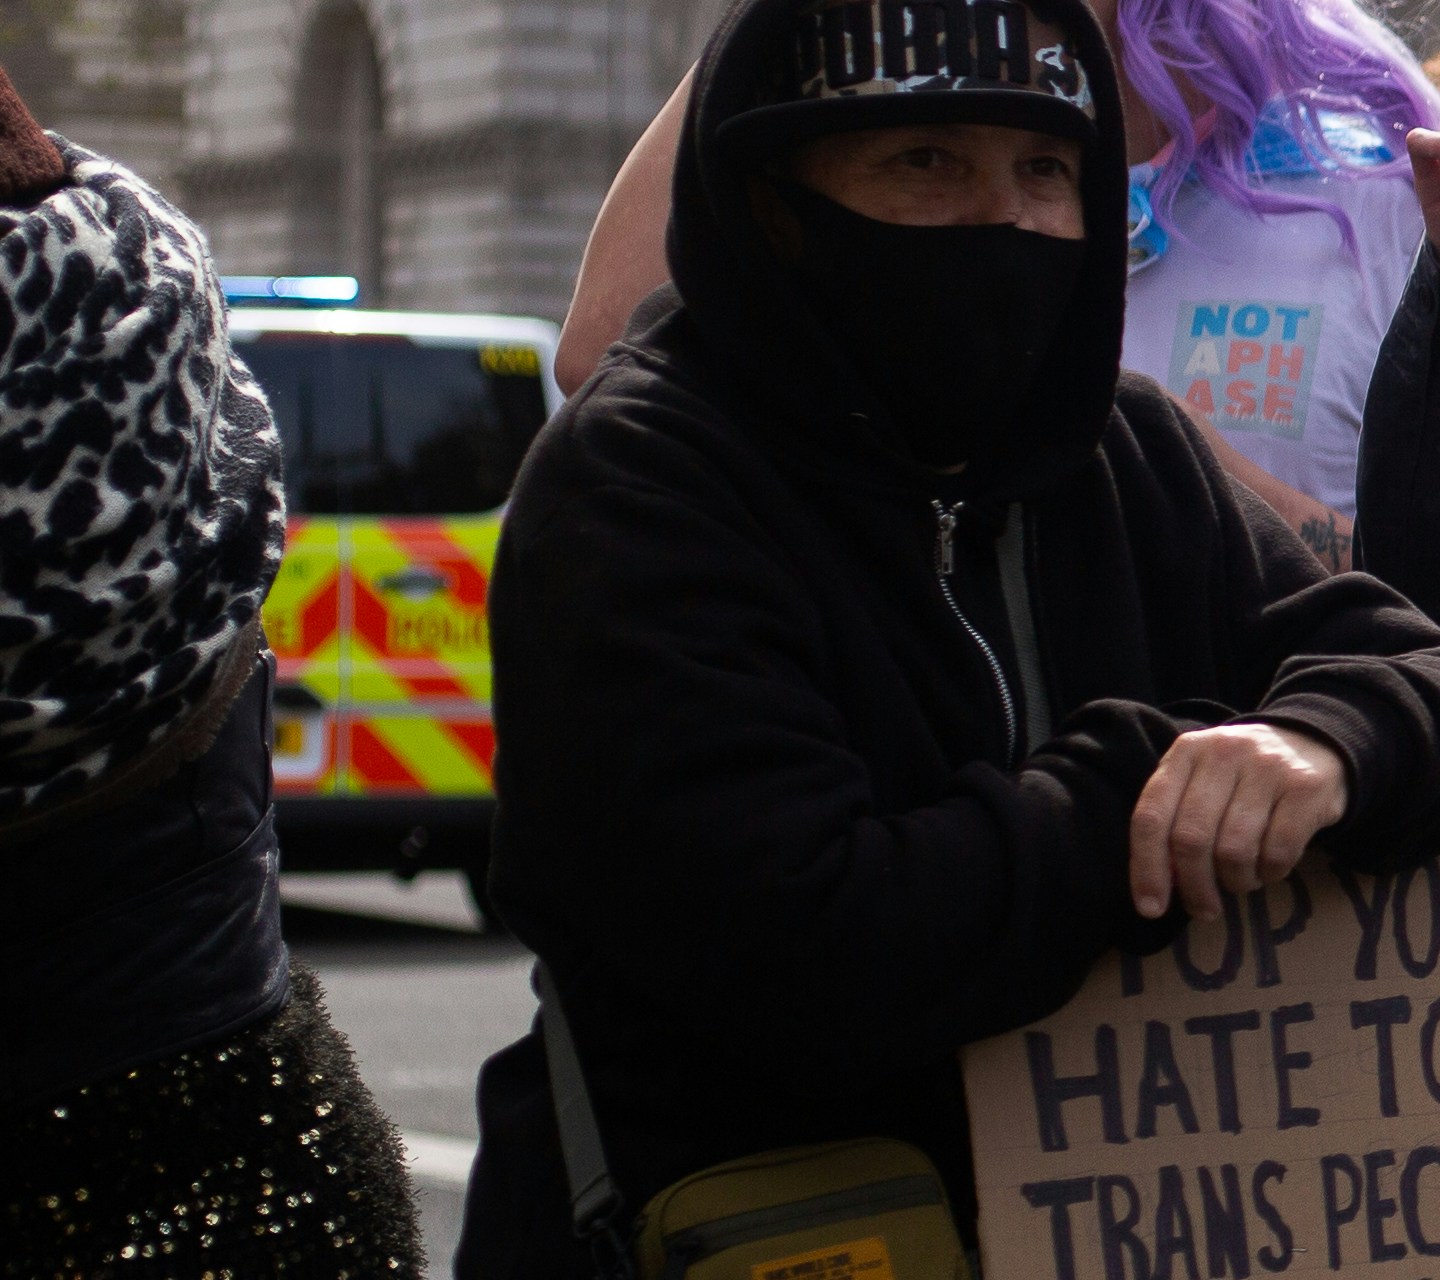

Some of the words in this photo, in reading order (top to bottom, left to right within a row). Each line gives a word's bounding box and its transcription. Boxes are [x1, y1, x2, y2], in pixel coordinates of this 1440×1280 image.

[1190, 303, 1311, 342] NOT
[1183, 340, 1222, 376] A
[1226, 340, 1306, 383] PH
[1185, 378, 1298, 425] ASE
[1119, 868, 1312, 997] OP
[1026, 1002, 1321, 1152] HATE
